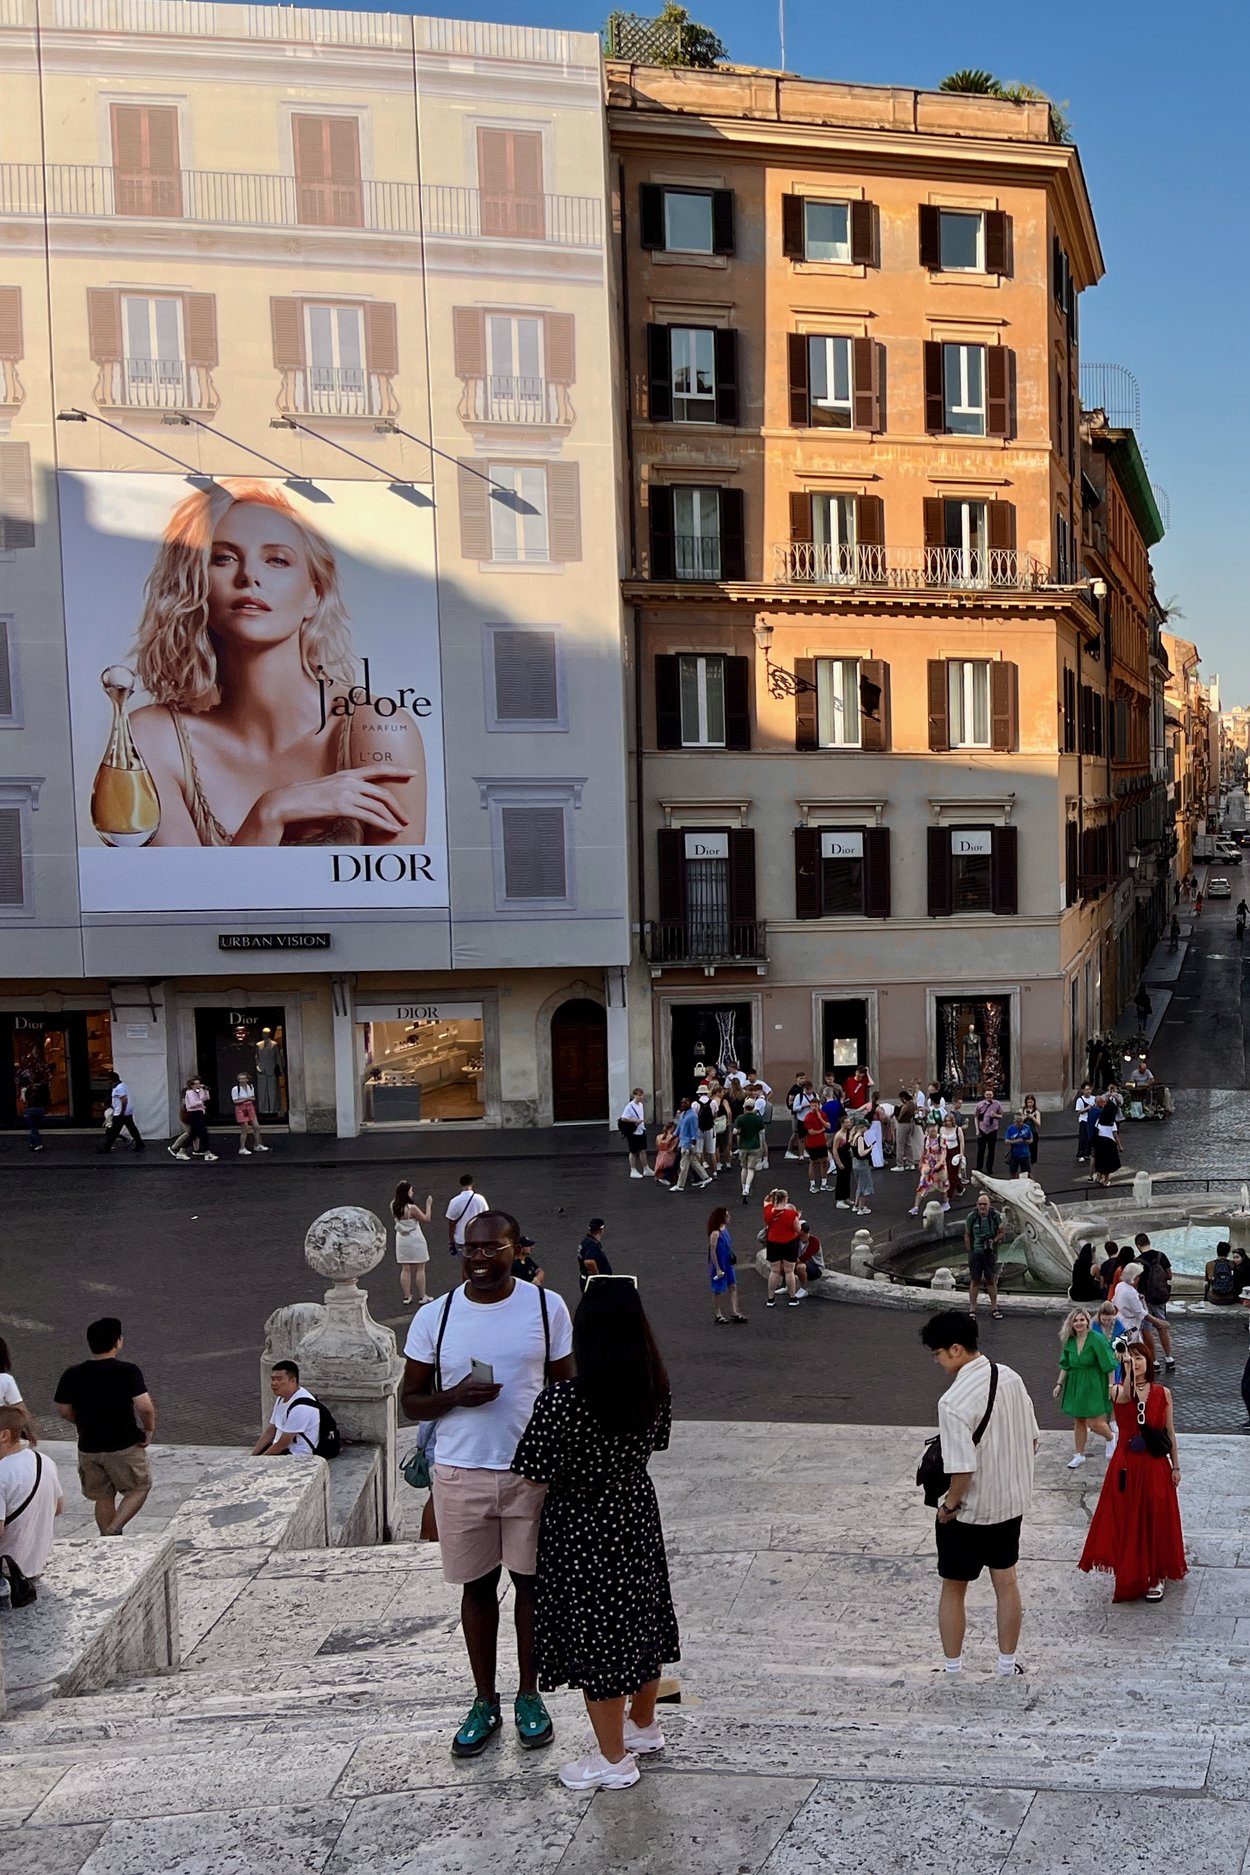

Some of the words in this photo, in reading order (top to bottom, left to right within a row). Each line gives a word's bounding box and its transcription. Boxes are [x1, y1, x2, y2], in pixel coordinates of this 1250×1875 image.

[362, 724, 408, 732] PARFUM
[694, 844, 721, 856] Dior
[831, 843, 856, 855] Dior
[960, 841, 984, 852] Dior
[329, 853, 436, 883] DIOR
[221, 936, 273, 948] URBAN
[277, 935, 327, 947] VISION
[229, 1012, 260, 1025] Dior
[397, 1007, 440, 1019] DIOR
[15, 1017, 45, 1029] Dior
